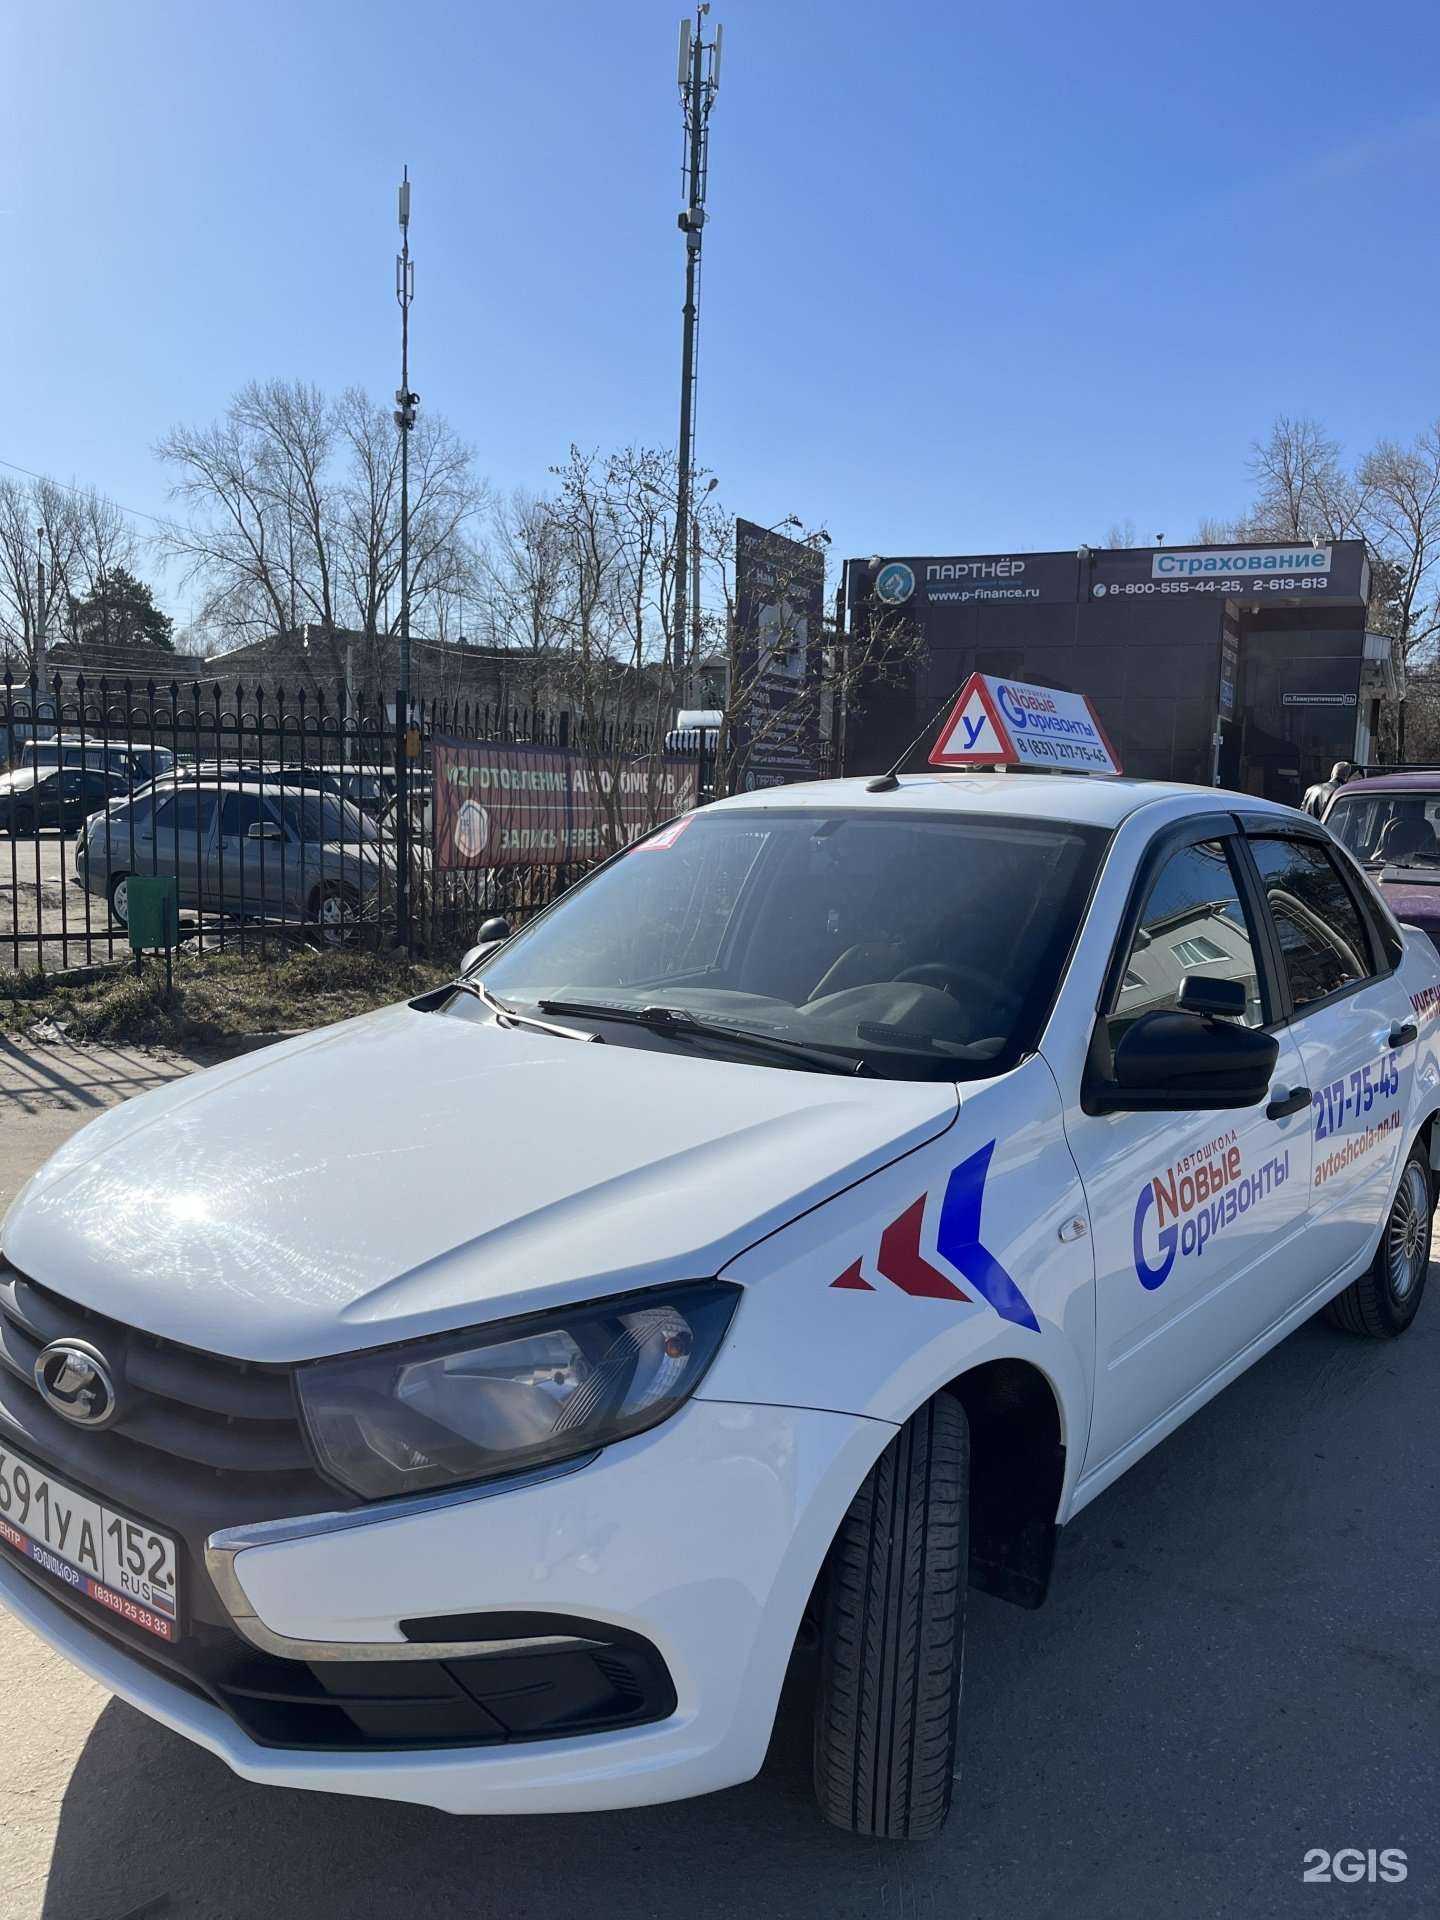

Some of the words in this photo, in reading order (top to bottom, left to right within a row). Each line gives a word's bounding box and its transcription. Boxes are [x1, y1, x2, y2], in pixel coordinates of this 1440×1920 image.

[926, 558, 1025, 580] ПАРТНЁР
[1158, 553, 1326, 575] Страхование
[928, 588, 1040, 602] www.p-finance.ru
[1253, 577, 1328, 591] 2-613-613
[962, 715, 986, 749] У
[1017, 737, 1026, 752] 8
[1028, 738, 1056, 760] (831)
[1056, 742, 1107, 763] 217-75-45
[447, 766, 567, 792] ИЗГОТОВЛЕНИЕ
[572, 769, 675, 794] АООМЕОВ
[500, 828, 557, 850] ЗАПИСЬ
[1312, 1052, 1399, 1141] 217-75-45
[1177, 1129, 1237, 1176] АВТОШКОЛА
[1314, 1109, 1401, 1187] avtoshcola-nn.ru
[107, 1518, 167, 1590] 152
[120, 1571, 151, 1601] RUS
[93, 1583, 123, 1612] (8313)
[124, 1602, 137, 1619] 25
[138, 1609, 152, 1626] 33
[153, 1617, 168, 1635] 33
